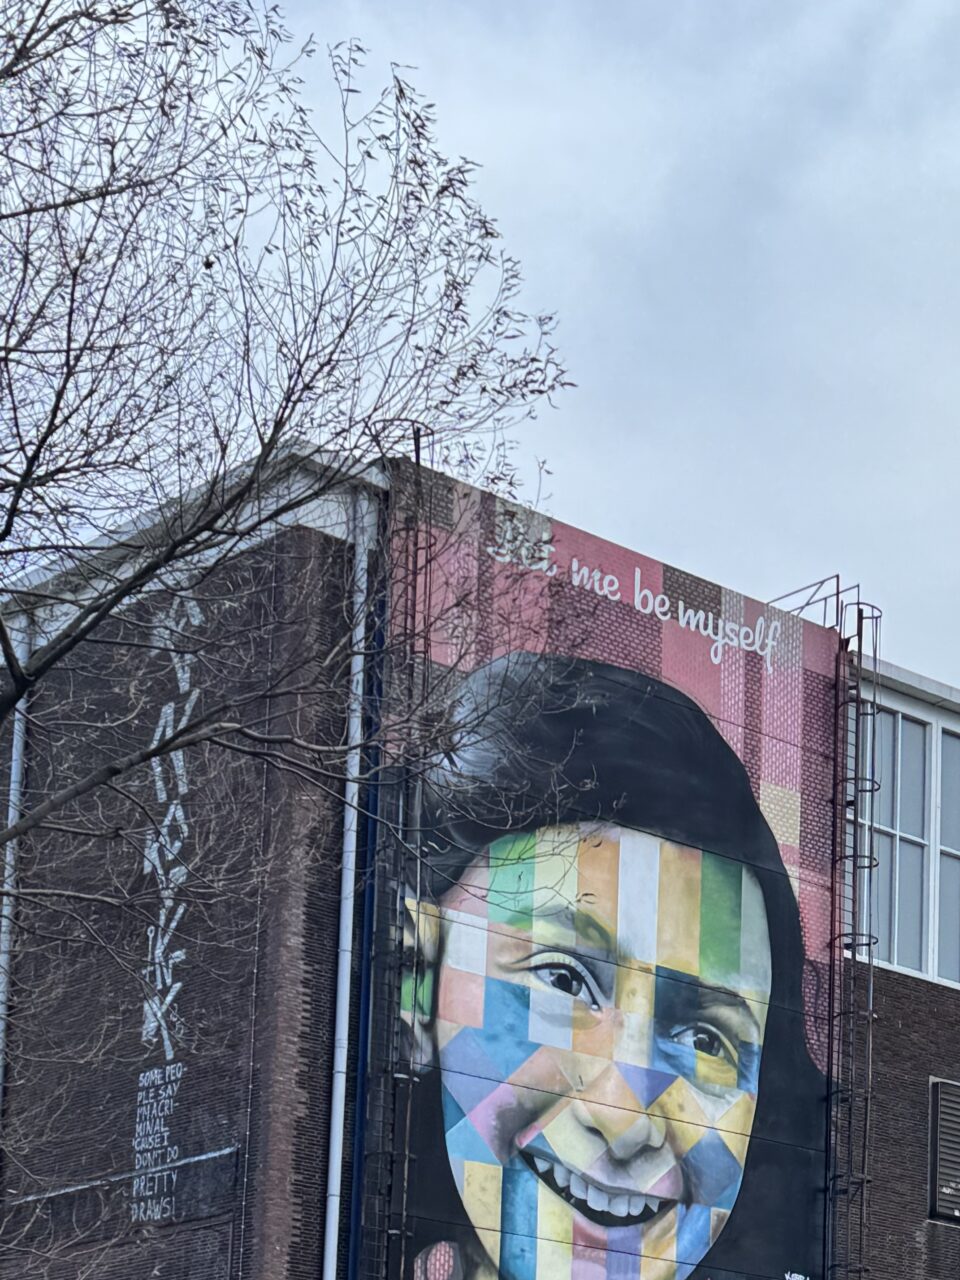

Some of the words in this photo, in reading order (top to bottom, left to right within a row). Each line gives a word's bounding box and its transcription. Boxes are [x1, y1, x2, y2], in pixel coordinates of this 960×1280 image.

[571, 557, 621, 601] me
[634, 566, 671, 621] be
[678, 600, 781, 675] myself
[138, 1068, 164, 1087] SOME
[137, 1088, 155, 1106] PLE
[159, 1080, 181, 1099] SAY
[135, 1117, 170, 1138] MINAL
[166, 1145, 179, 1163] DO
[132, 1170, 178, 1198] PRETTY
